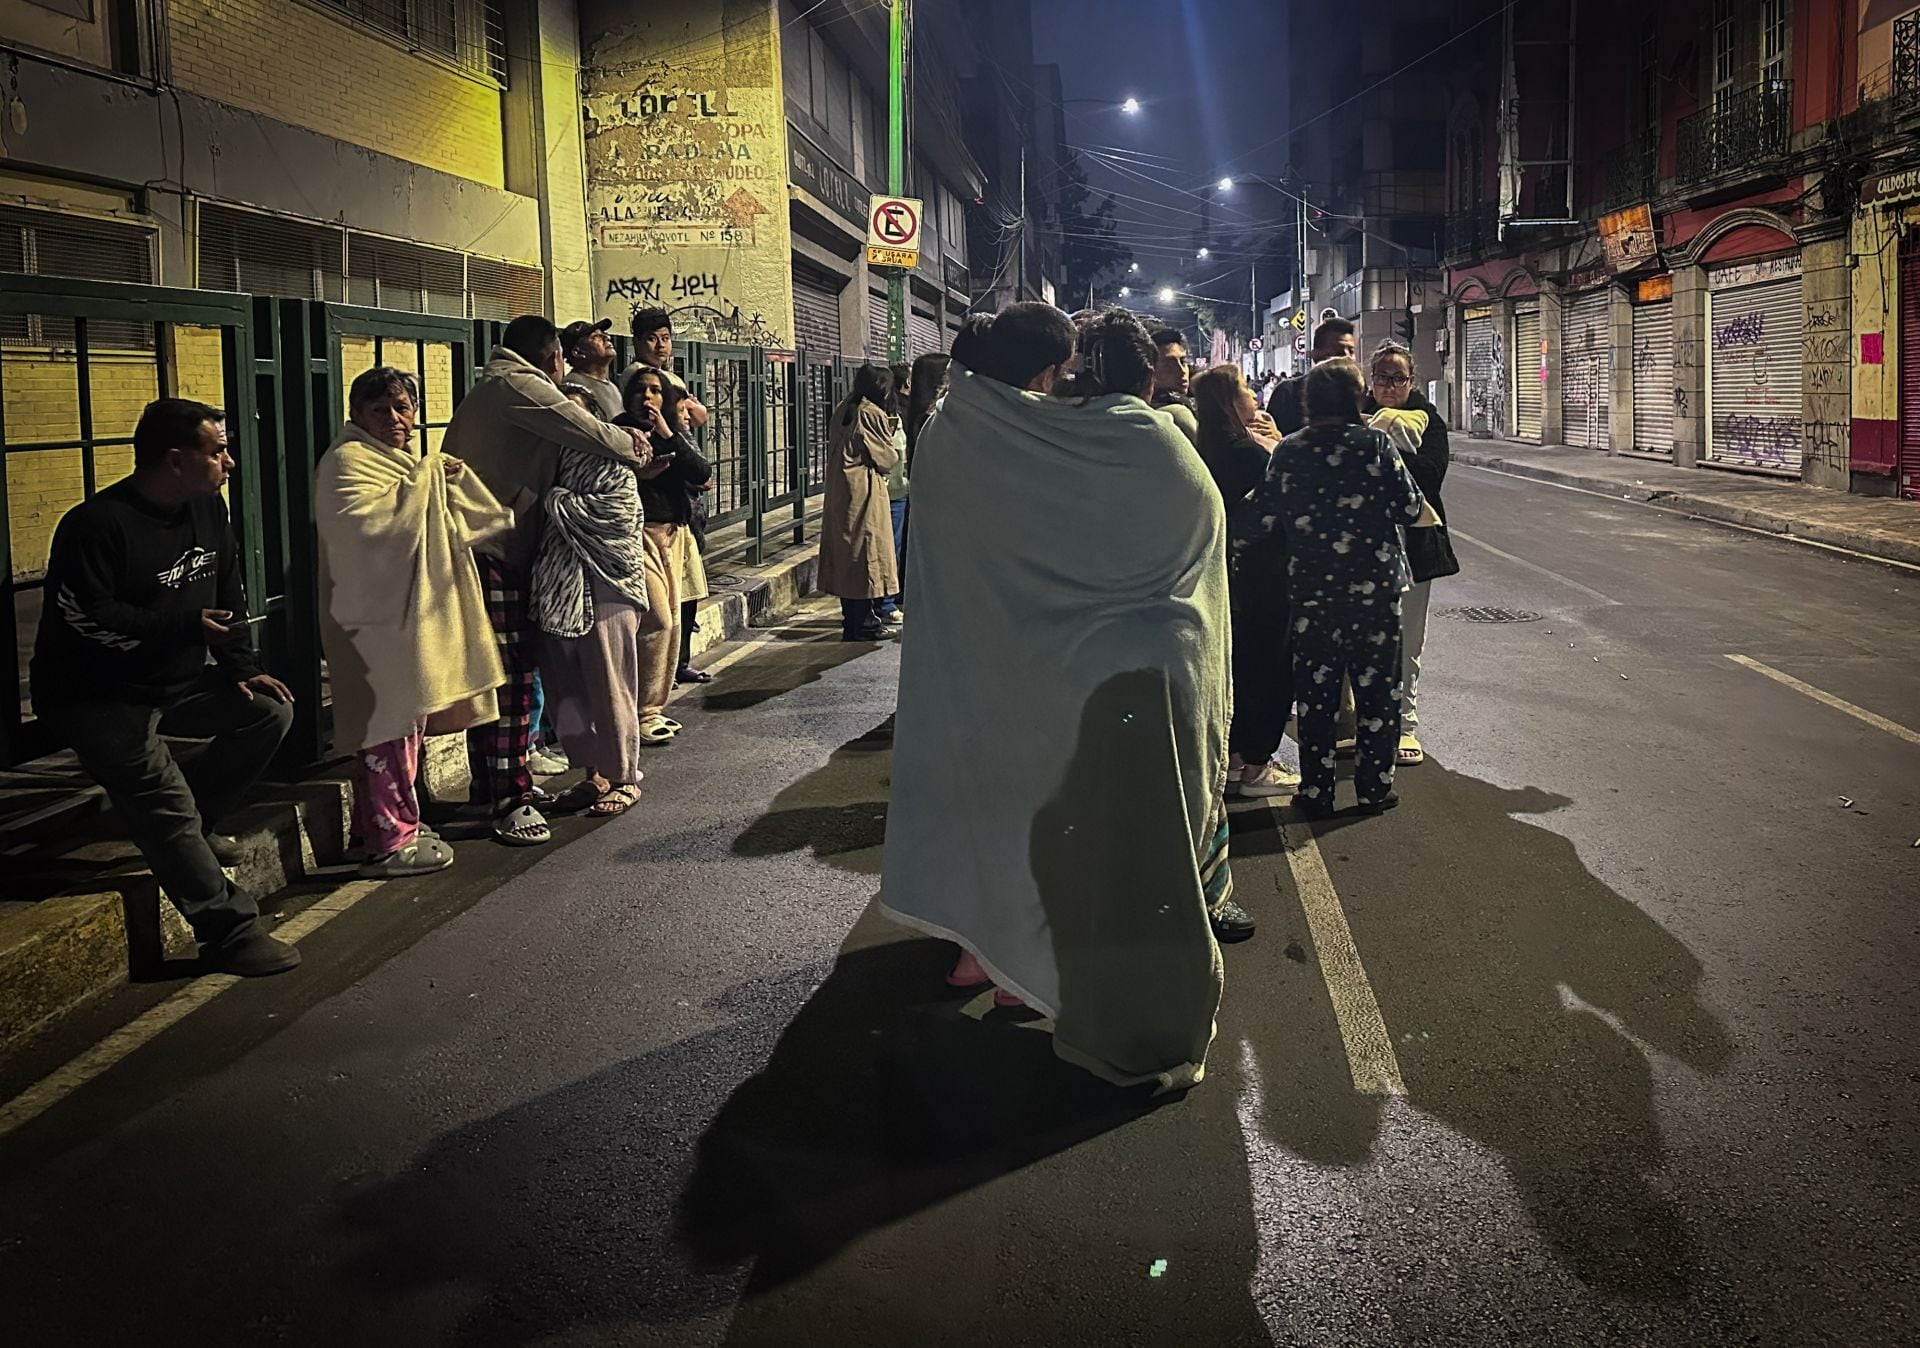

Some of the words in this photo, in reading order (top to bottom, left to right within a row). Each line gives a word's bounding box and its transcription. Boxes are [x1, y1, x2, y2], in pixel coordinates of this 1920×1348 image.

[1877, 173, 1906, 194] CALDOS
[1906, 170, 1917, 188] DE
[720, 231, 744, 243] 158
[885, 251, 913, 260] USARA
